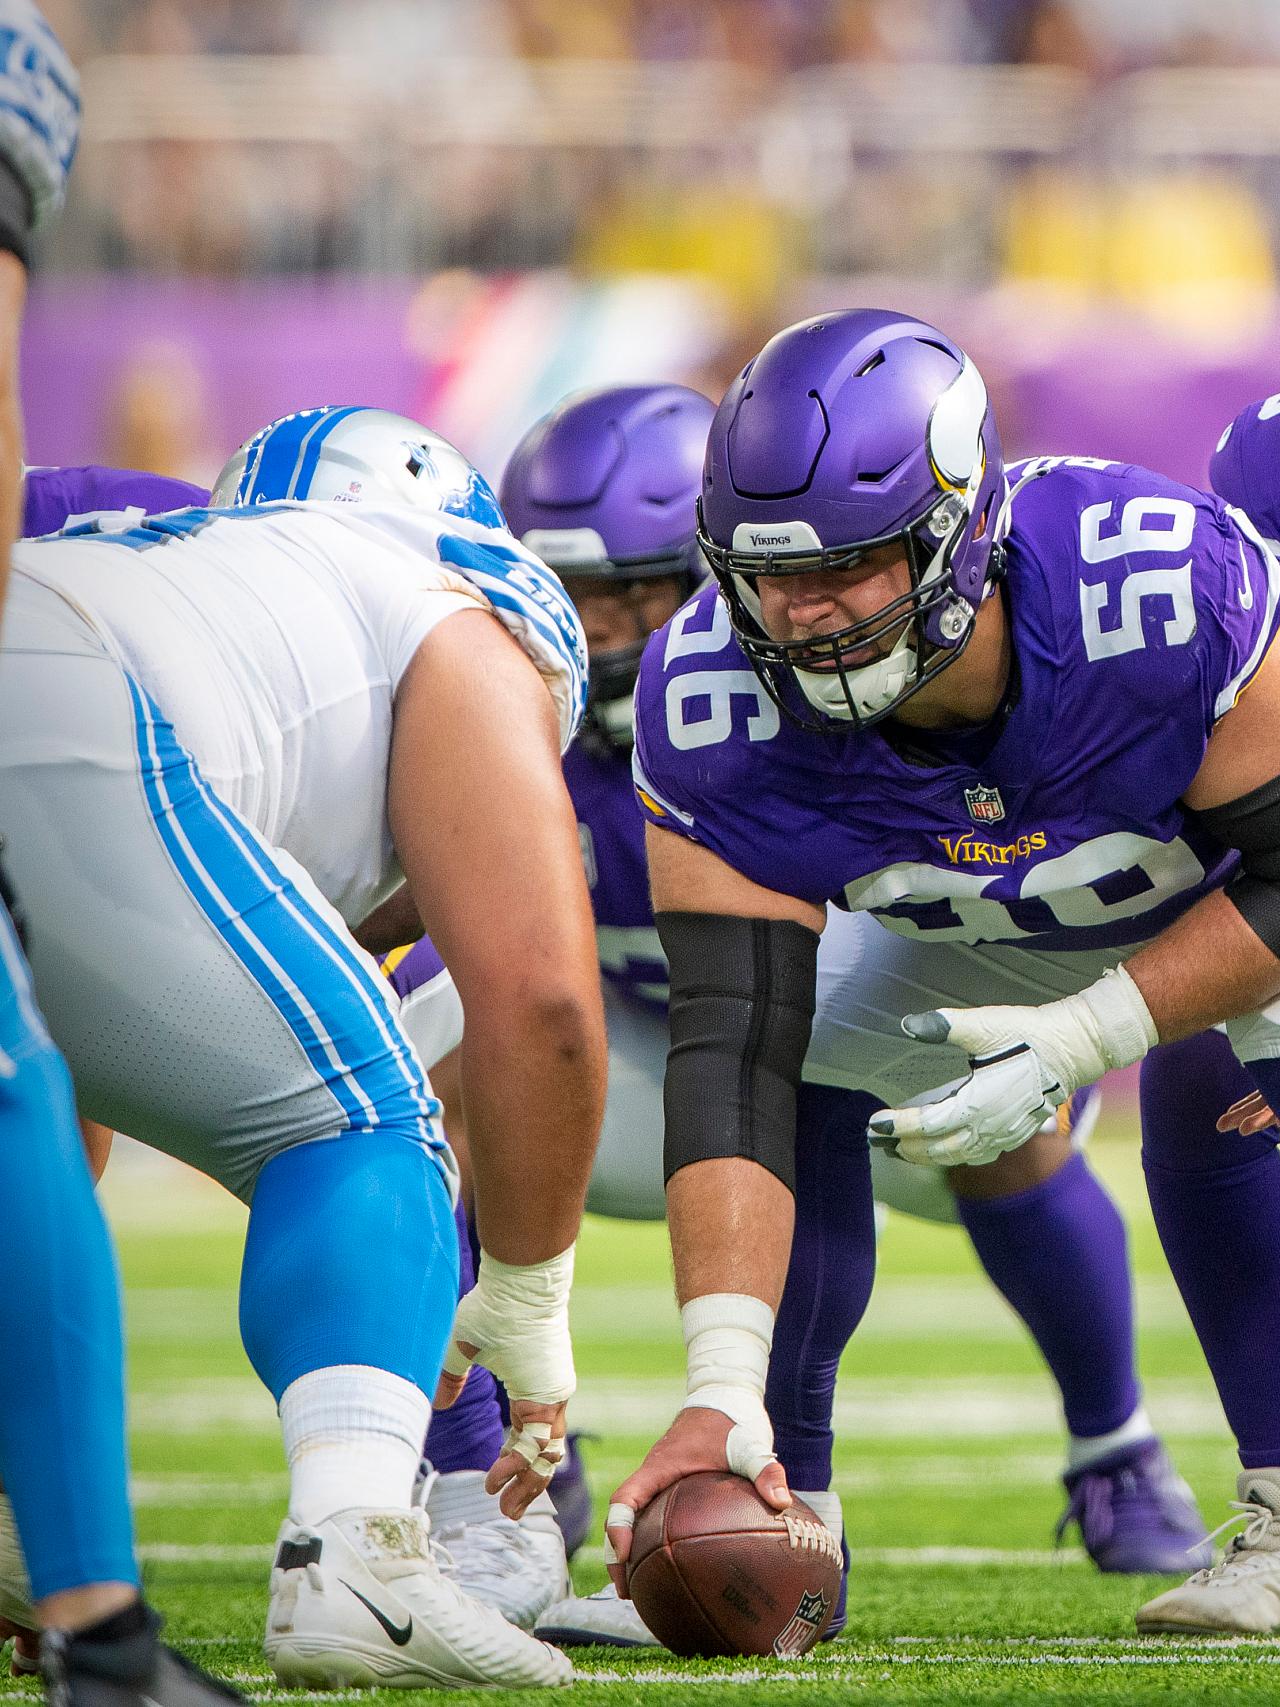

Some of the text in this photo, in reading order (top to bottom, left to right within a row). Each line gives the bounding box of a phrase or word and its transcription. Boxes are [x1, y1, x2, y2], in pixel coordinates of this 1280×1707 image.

[750, 533, 791, 547] VIKINGS
[1080, 496, 1197, 663] 56
[972, 802, 999, 818] NFL
[938, 827, 1047, 866] VIKINGS
